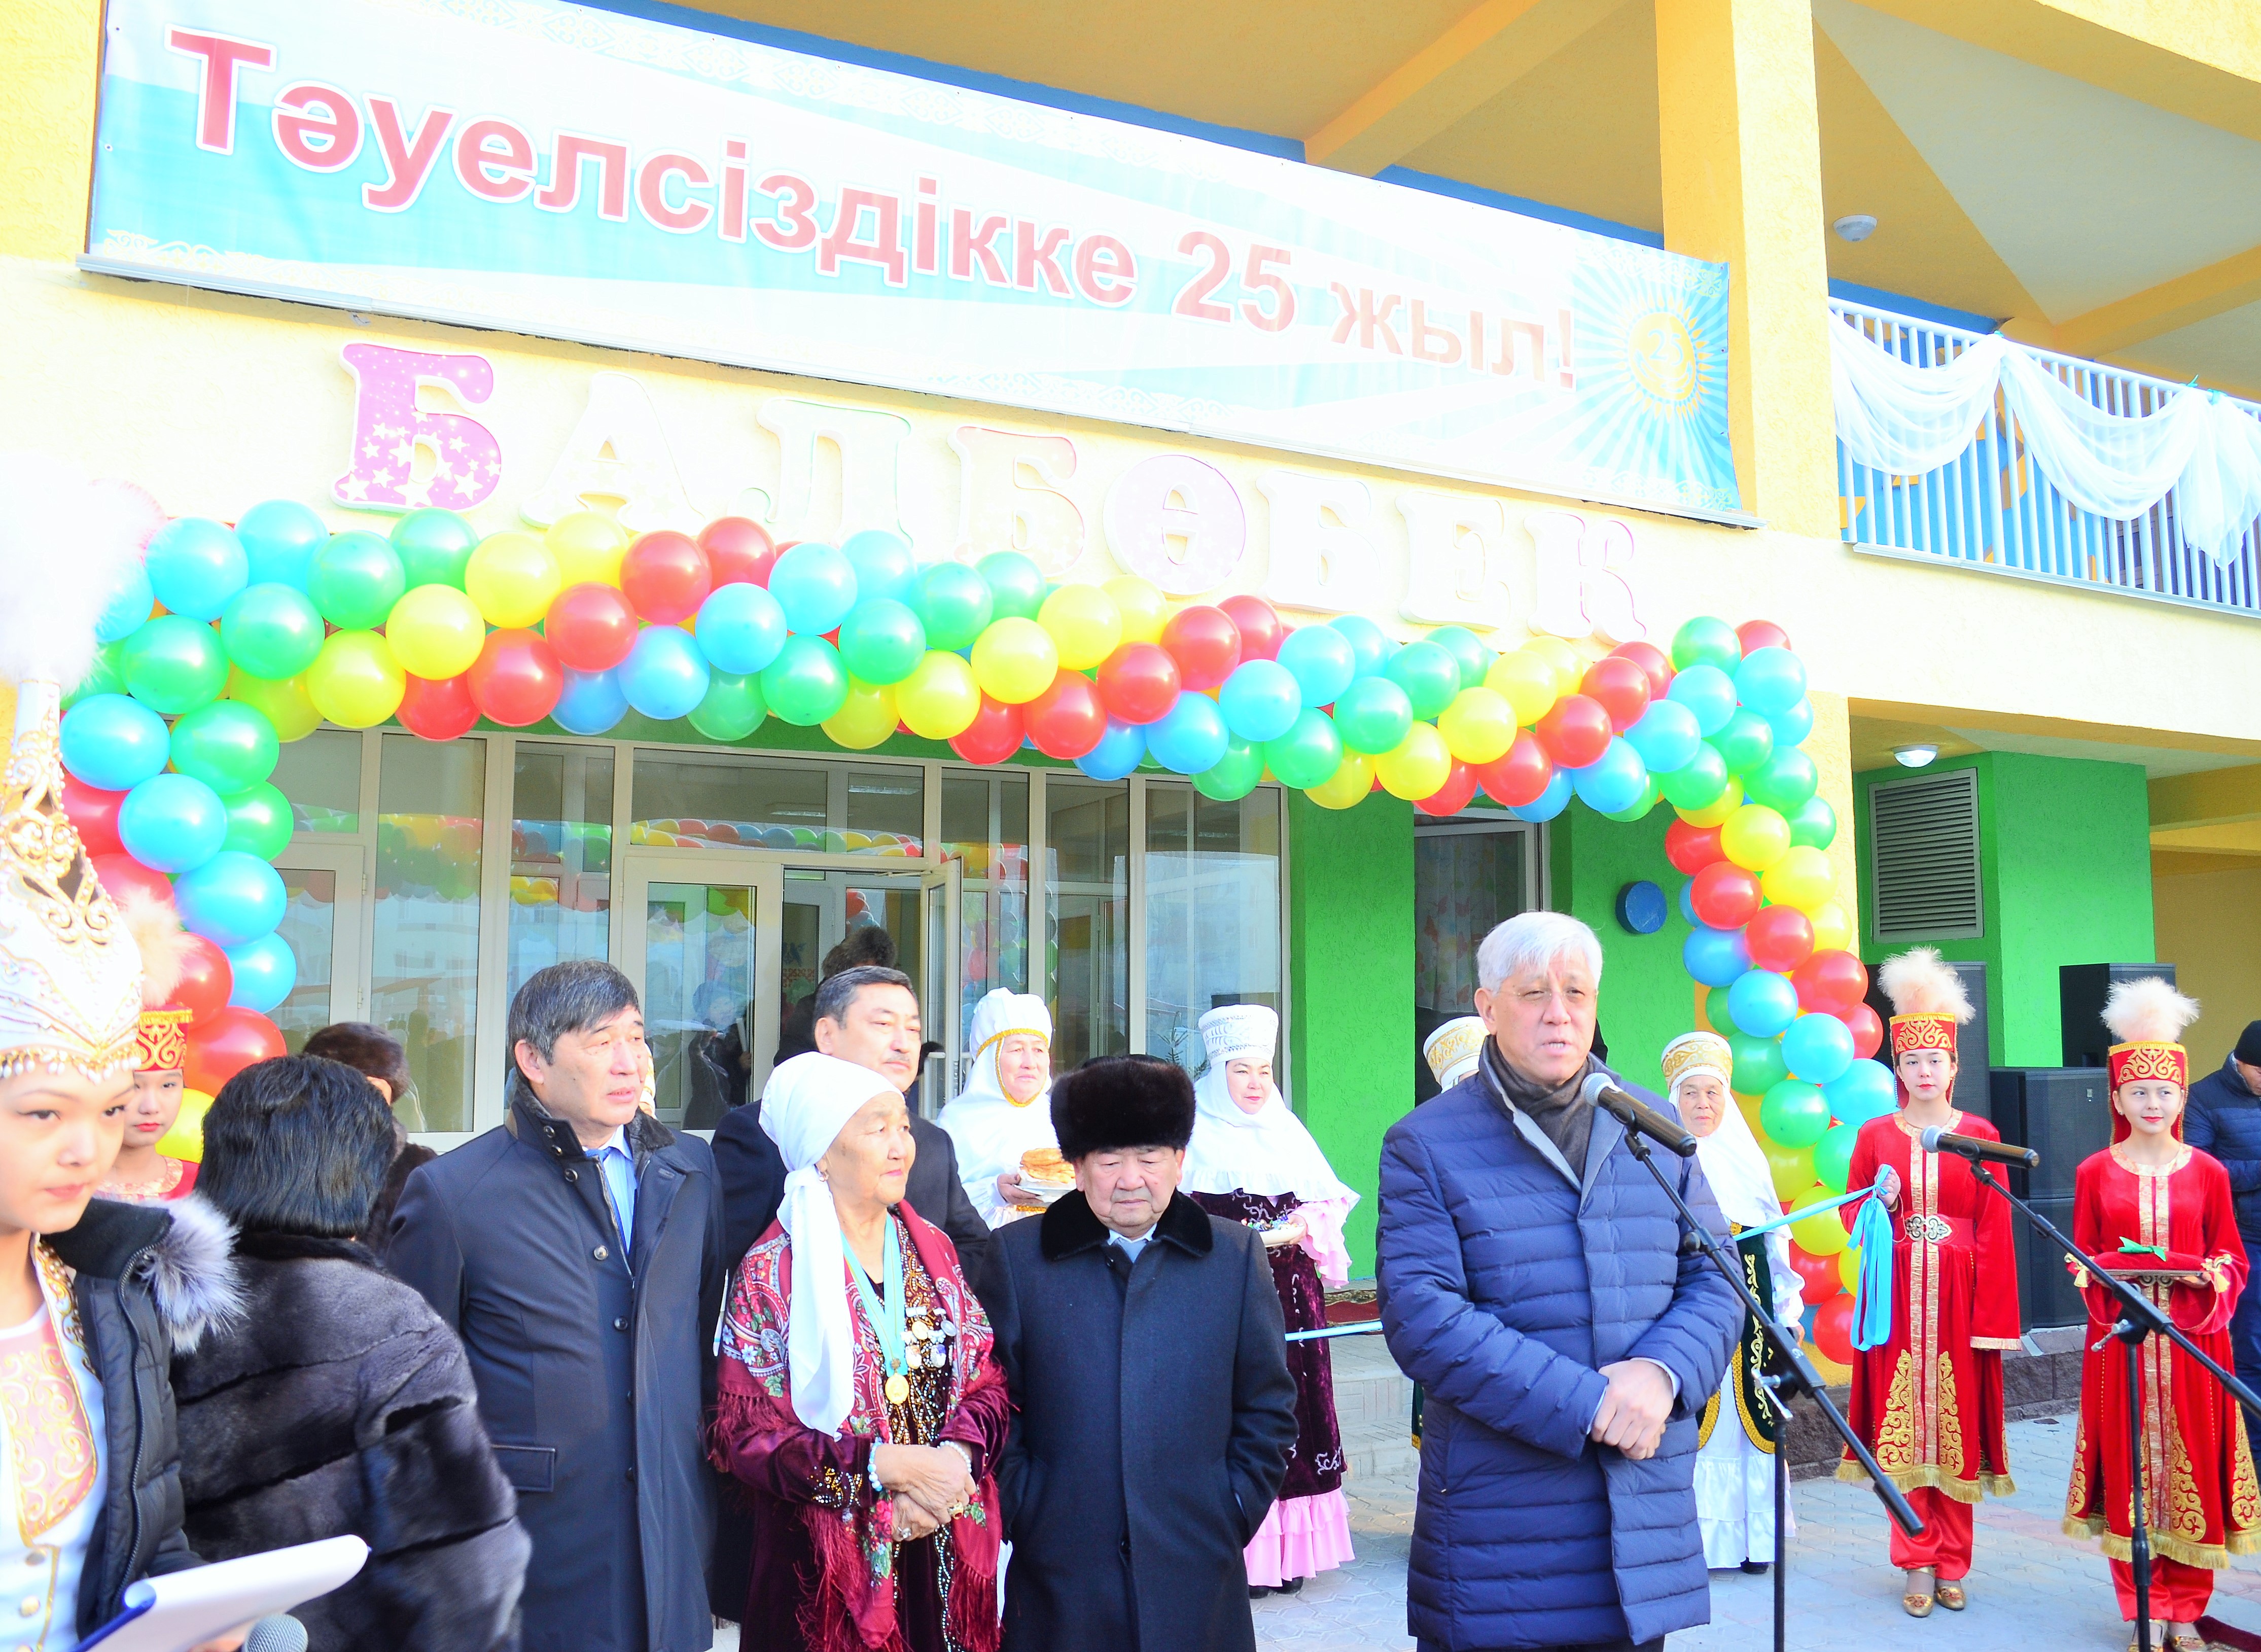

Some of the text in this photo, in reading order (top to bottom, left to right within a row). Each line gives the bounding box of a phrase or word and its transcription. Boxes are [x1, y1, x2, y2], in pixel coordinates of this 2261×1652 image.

[169, 28, 1573, 389] Тәуелсіздікке 25 жыл!
[1647, 328, 1683, 366] 25
[331, 342, 1647, 645] БАЛБӨБЕК
